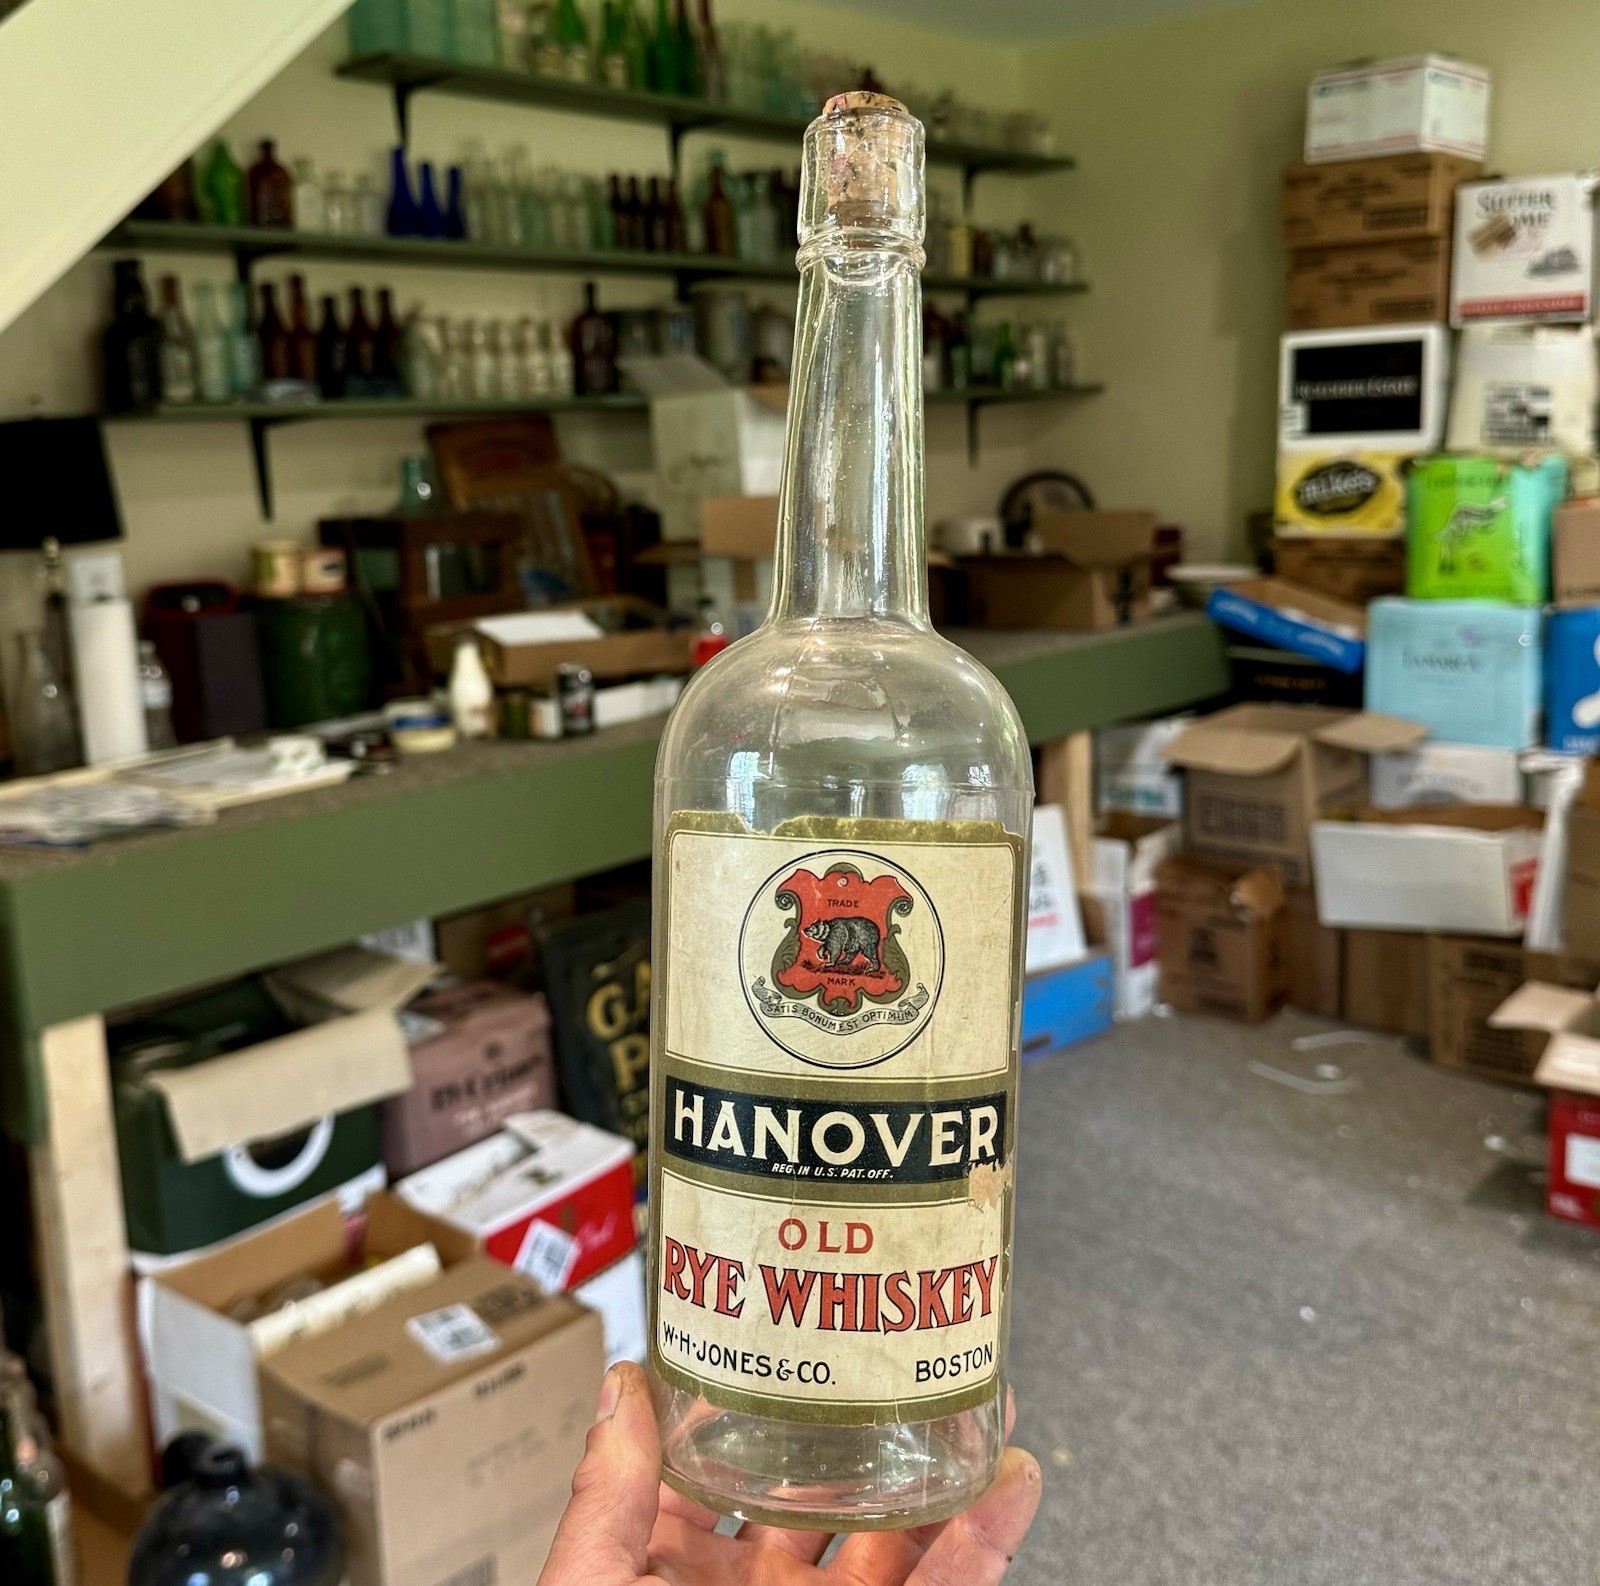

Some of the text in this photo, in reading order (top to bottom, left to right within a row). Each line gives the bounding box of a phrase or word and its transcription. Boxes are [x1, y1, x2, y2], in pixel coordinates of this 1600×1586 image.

[827, 899, 860, 909] TRADE
[827, 977, 856, 987] MARK
[766, 1003, 913, 1033] SATIS BONUM EST OPTIMUM
[674, 1088, 999, 1168] HANOVER
[813, 1165, 839, 1178] U.S.
[777, 1218, 875, 1255] OLD
[663, 1236, 746, 1320] RYE
[758, 1254, 999, 1336] WHISKEY
[914, 1341, 994, 1383] BOSTON
